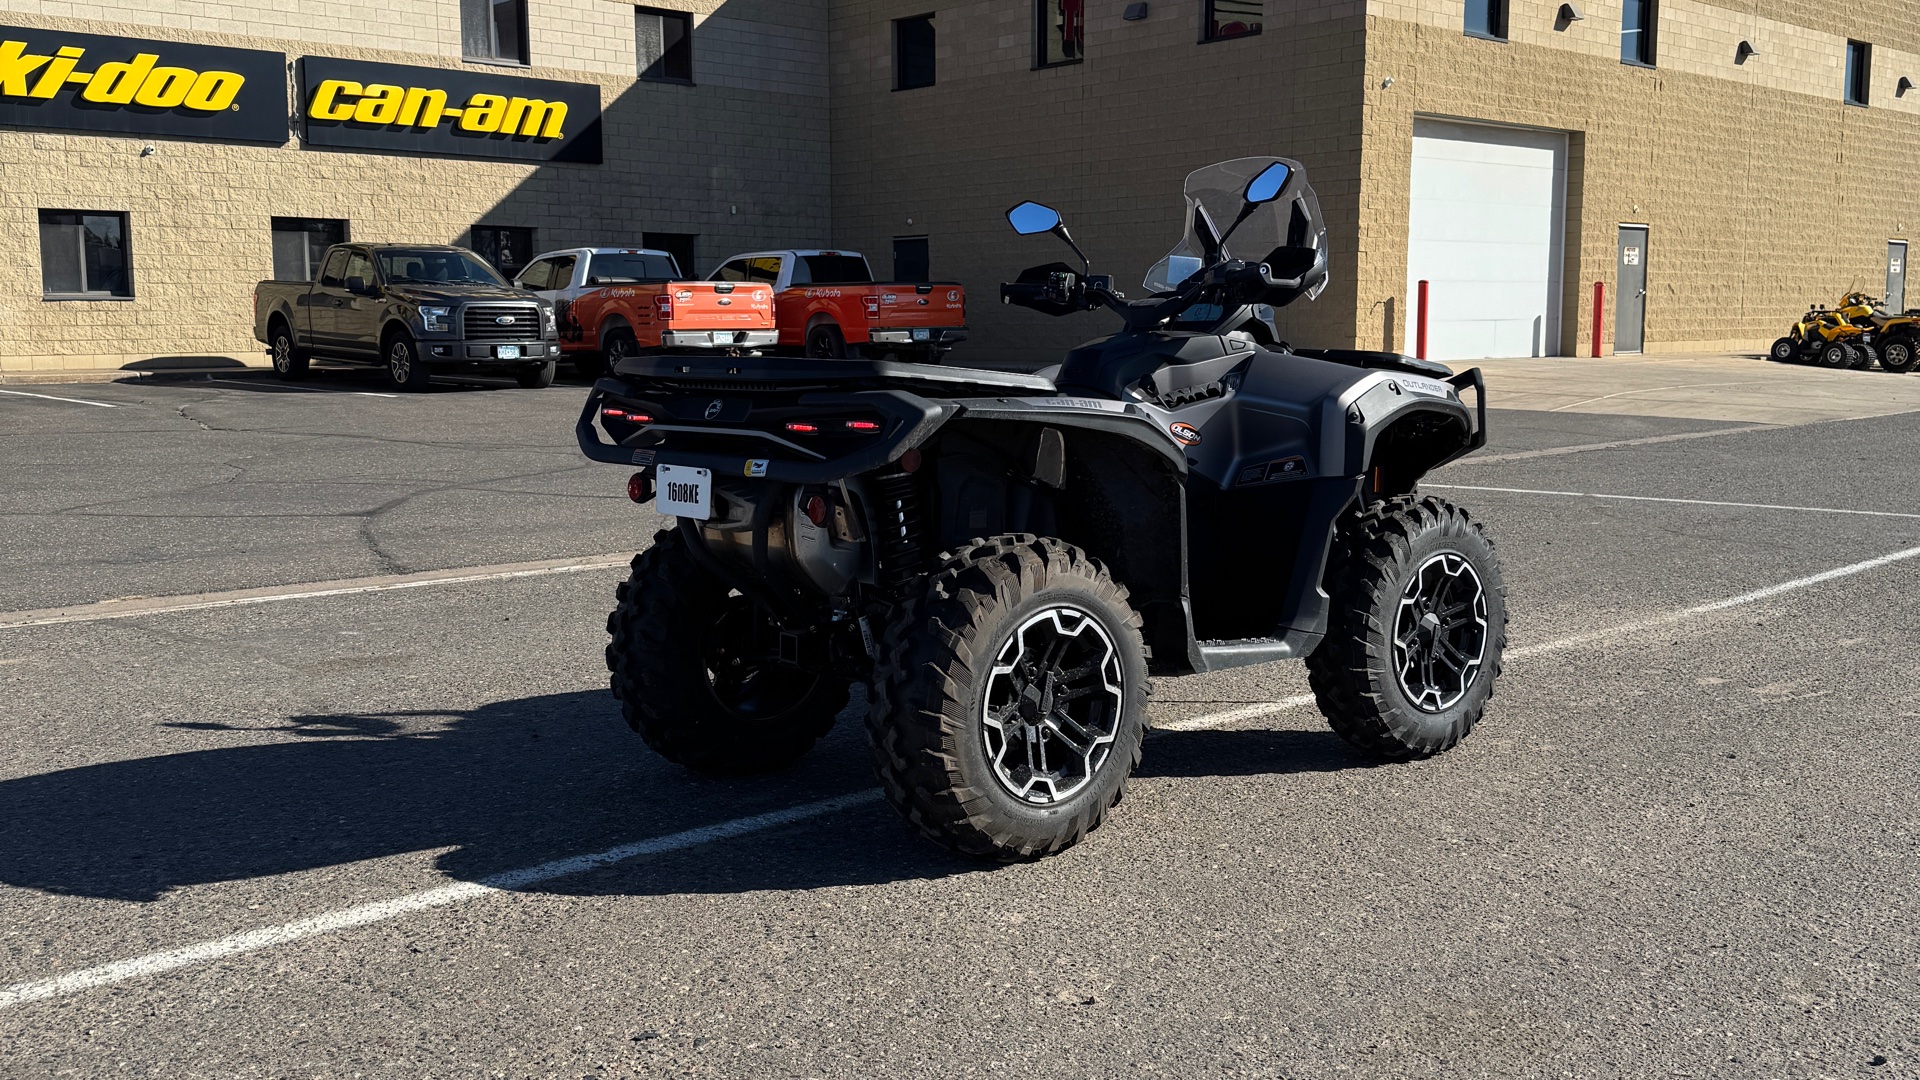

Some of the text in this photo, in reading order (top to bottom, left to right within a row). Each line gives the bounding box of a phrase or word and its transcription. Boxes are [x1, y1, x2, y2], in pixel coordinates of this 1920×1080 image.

[0, 40, 246, 111] ki-doo
[308, 79, 569, 139] can-am
[610, 287, 636, 298] Kubota
[815, 288, 841, 298] Kubota
[1402, 379, 1443, 393] OUTLANDER
[1172, 424, 1201, 441] OLSON
[667, 481, 699, 504] 1608KE
